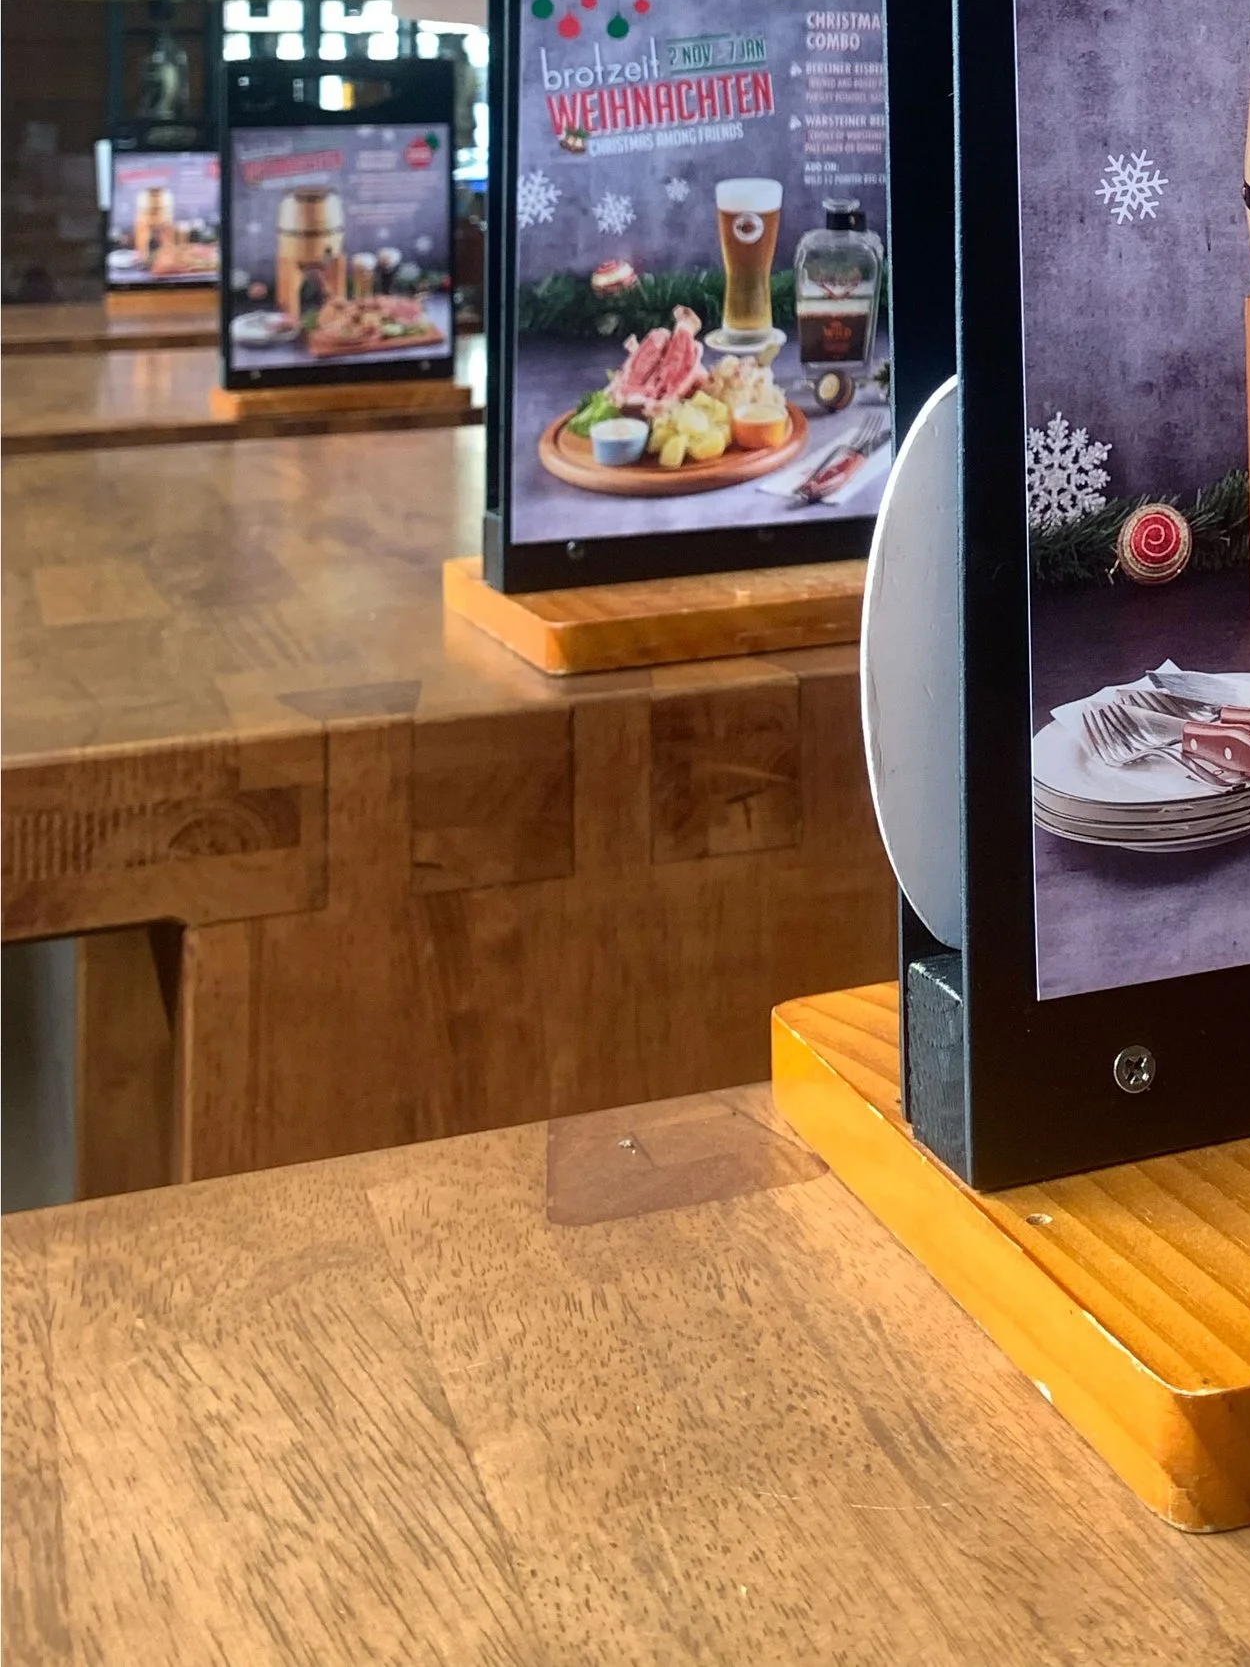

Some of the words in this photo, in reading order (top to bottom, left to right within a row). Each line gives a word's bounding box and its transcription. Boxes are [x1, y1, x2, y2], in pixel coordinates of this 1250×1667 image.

[806, 11, 880, 30] CHRISTMA
[682, 43, 713, 67] NOV
[741, 38, 766, 62] JAN
[806, 32, 860, 51] COMBO
[540, 36, 660, 91] brotzeit
[546, 70, 775, 138] WEIHNACHTEN
[588, 133, 654, 157] CHRISTMAS
[656, 128, 696, 148] AMONG
